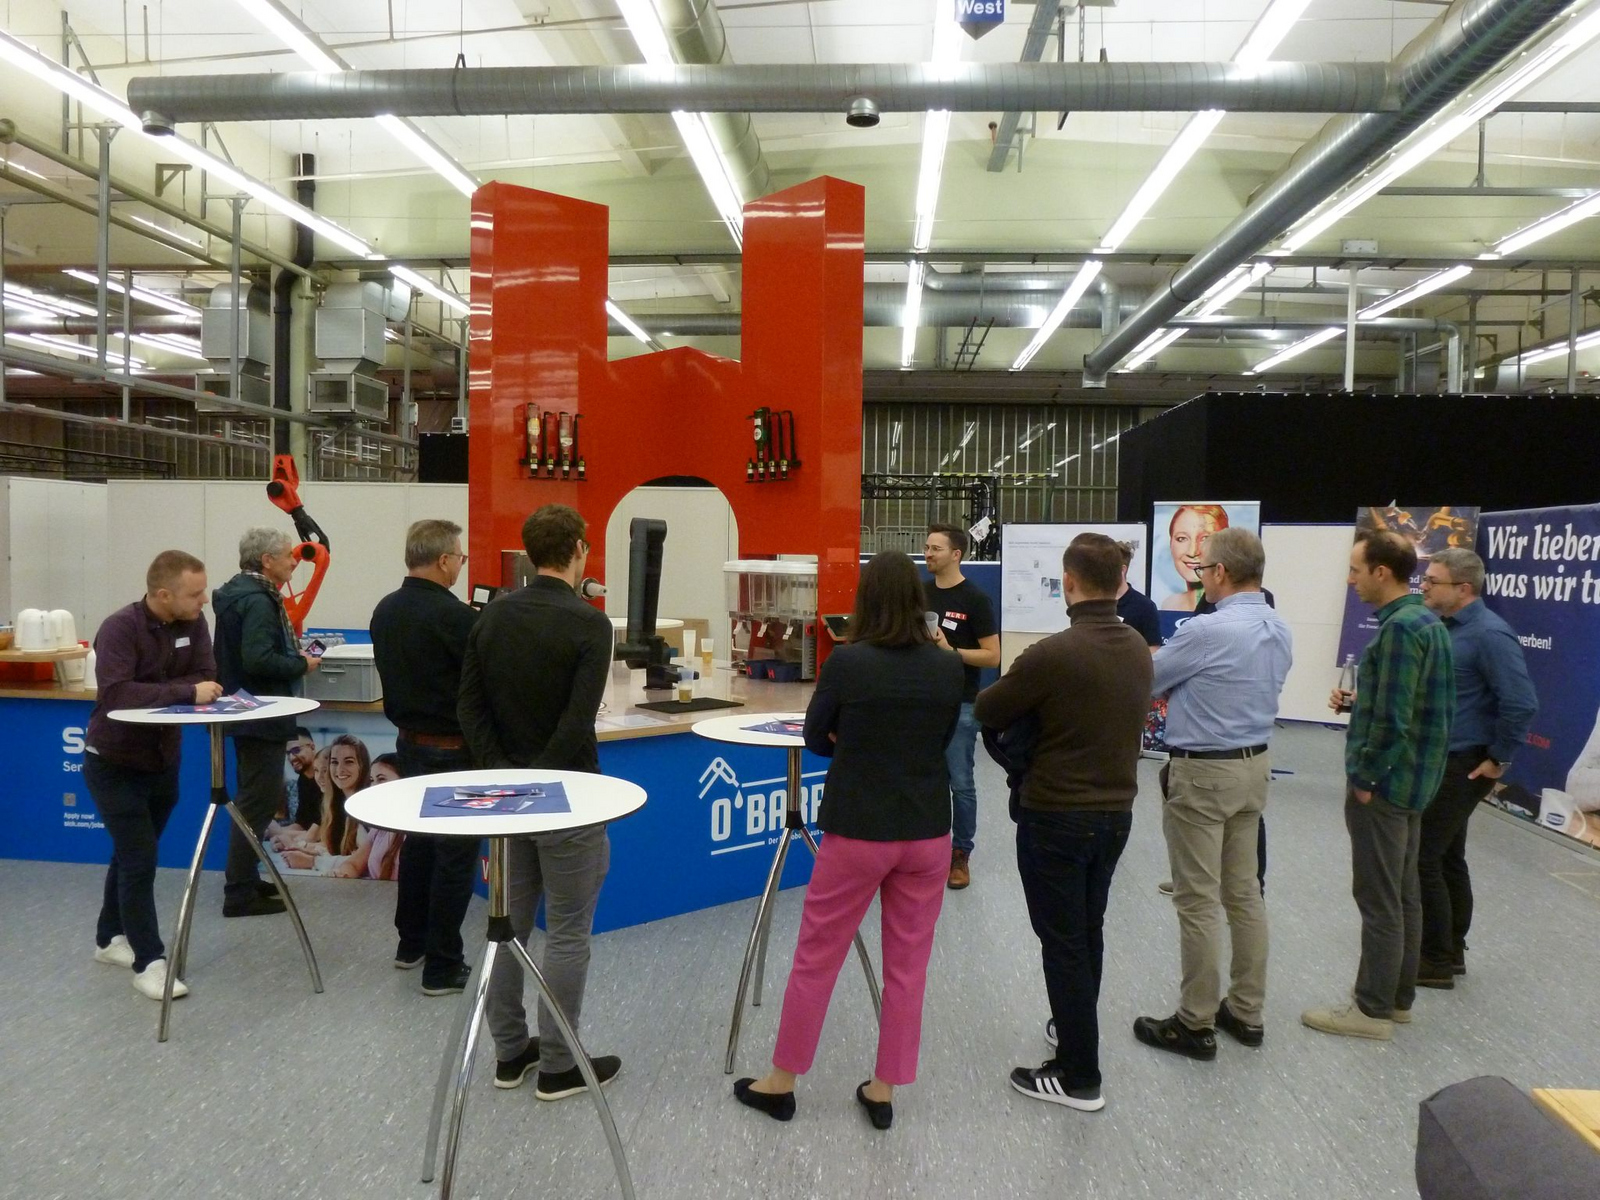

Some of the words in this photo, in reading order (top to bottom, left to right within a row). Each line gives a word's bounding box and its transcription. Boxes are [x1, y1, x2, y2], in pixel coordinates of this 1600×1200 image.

[957, 0, 1002, 14] West
[1488, 525, 1528, 559] Wir
[1485, 573, 1528, 598] was
[1533, 565, 1577, 601] wir
